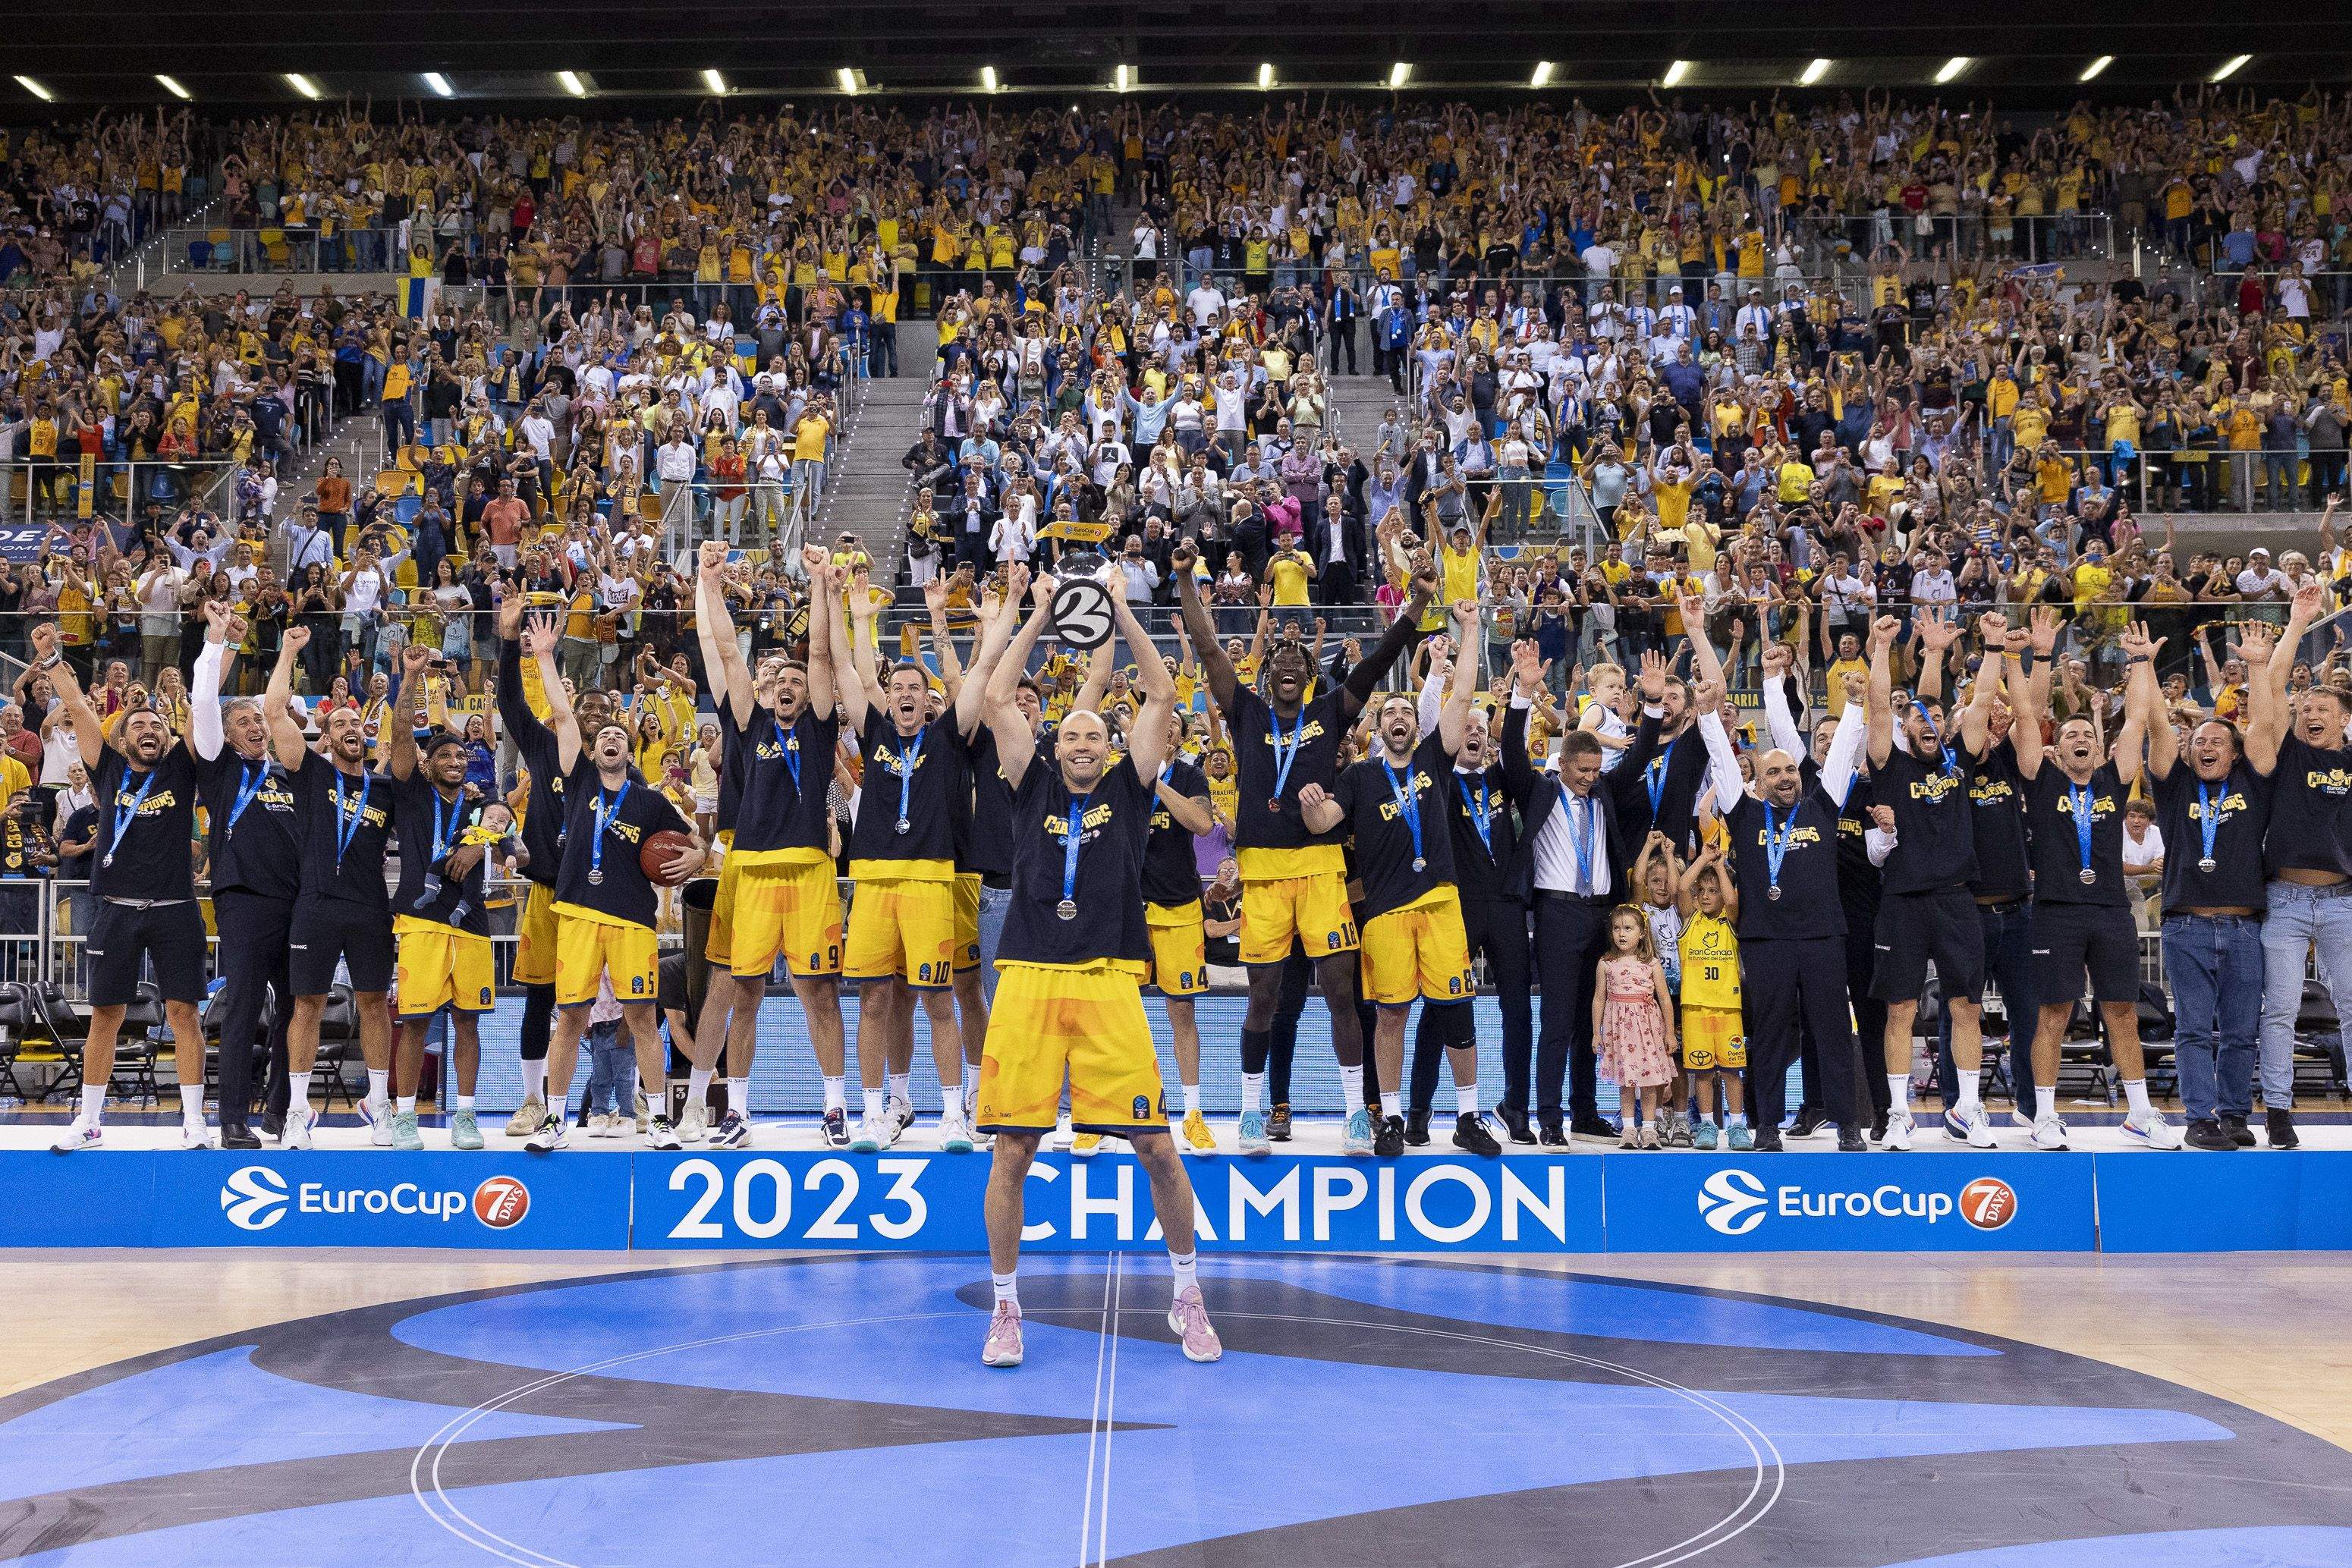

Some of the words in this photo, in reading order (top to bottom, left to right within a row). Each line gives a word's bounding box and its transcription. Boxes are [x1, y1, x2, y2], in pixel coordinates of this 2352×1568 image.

[1725, 695, 1759, 708] NARIA
[1043, 803, 1112, 835] CHAIONS
[828, 944, 839, 970] 9
[648, 970, 655, 995] 5
[933, 960, 951, 985] 10
[1196, 965, 1209, 989] 4
[1463, 969, 1474, 993] 8
[1704, 967, 1718, 980] 30
[674, 1086, 687, 1100] 3
[300, 1183, 467, 1222] EuroCup
[484, 1183, 517, 1222] 7
[498, 1186, 524, 1221] DAYS
[667, 1158, 931, 1240] 2023
[1022, 1162, 1566, 1245] CHAMPION
[1778, 1185, 1953, 1224] EuroCup
[1969, 1185, 2001, 1224] 7
[1986, 1188, 2011, 1222] DAYS
